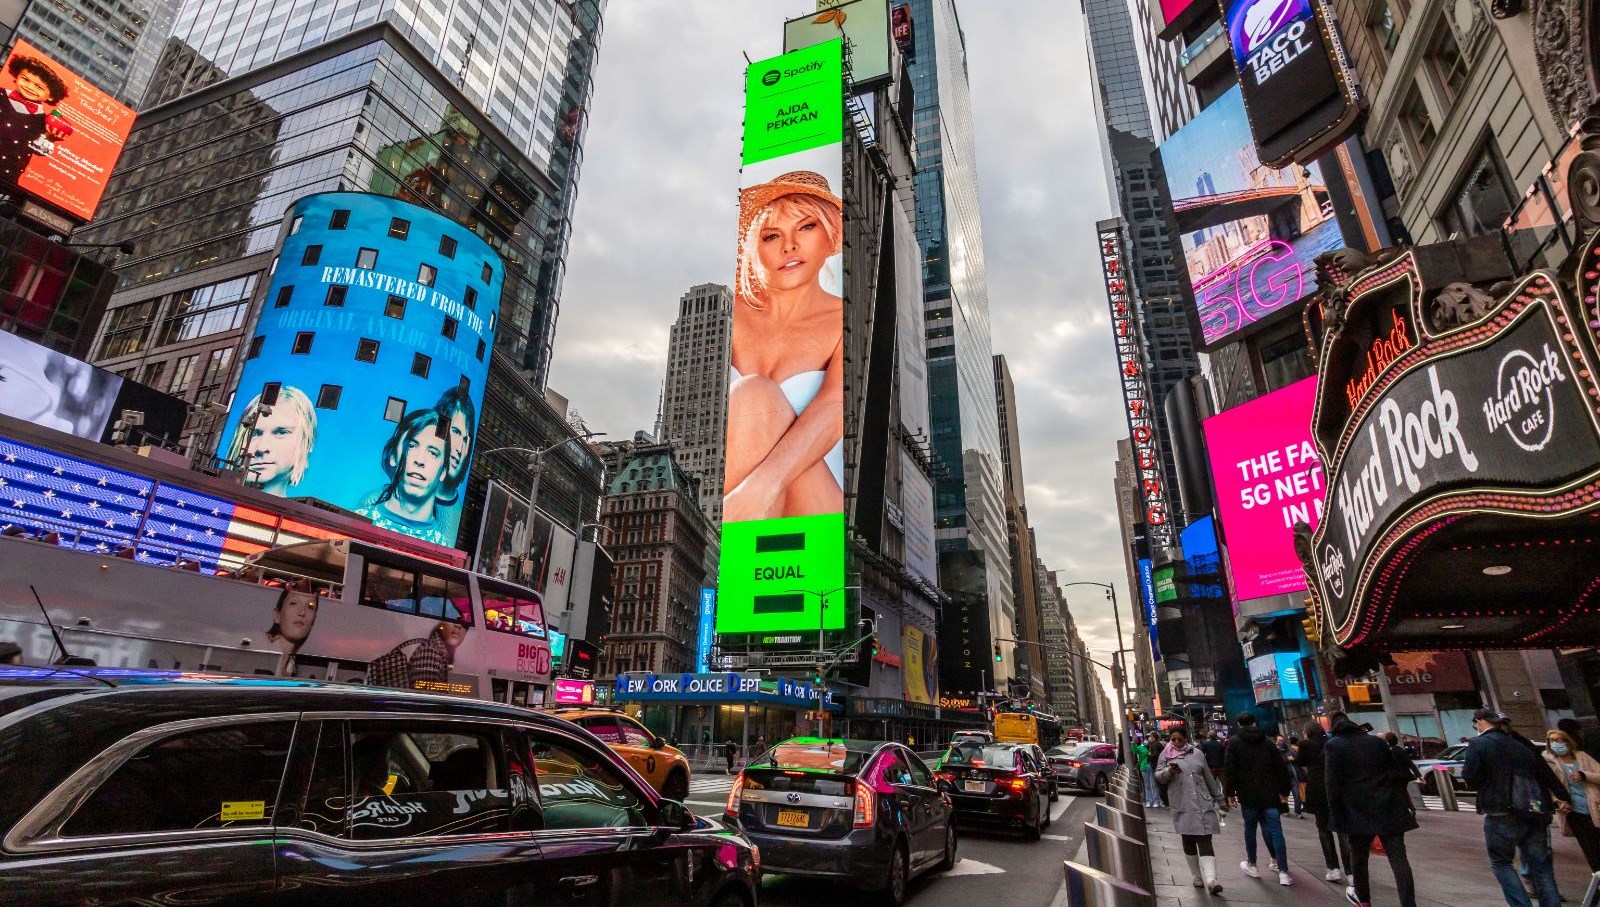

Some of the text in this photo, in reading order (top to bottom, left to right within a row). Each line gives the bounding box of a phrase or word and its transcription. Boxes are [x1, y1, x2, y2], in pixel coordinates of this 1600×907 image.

[894, 24, 909, 38] IFE
[1246, 21, 1306, 70] TACO
[783, 61, 824, 79] Spotify
[1254, 41, 1313, 86] BELL
[766, 111, 818, 132] PEKKAN
[776, 102, 809, 118] AJDA
[320, 266, 485, 338] REMASTERED FROM THE
[1103, 238, 1129, 337] ERNST
[1192, 239, 1305, 337] 5G
[278, 310, 470, 372] ORIGINAL ANALOG TAPES
[1123, 359, 1139, 378] &
[1346, 307, 1413, 413] Hard Rock
[1482, 342, 1565, 437] Hard Rock
[1521, 412, 1544, 436] CAFE
[1129, 399, 1164, 525] YOUNG
[1236, 440, 1319, 482] THE FA
[1338, 365, 1479, 561] Hard Rock
[1240, 466, 1322, 509] 5G NET
[1282, 501, 1311, 528] IN
[754, 566, 805, 581] EQUAL
[1321, 548, 1346, 582] Hard Rock
[704, 593, 712, 615] gopuff
[517, 658, 536, 674] BUS
[518, 643, 537, 660] BIG
[681, 672, 723, 693] POLICE
[727, 671, 762, 693] DEPT
[1396, 671, 1433, 685] cafe
